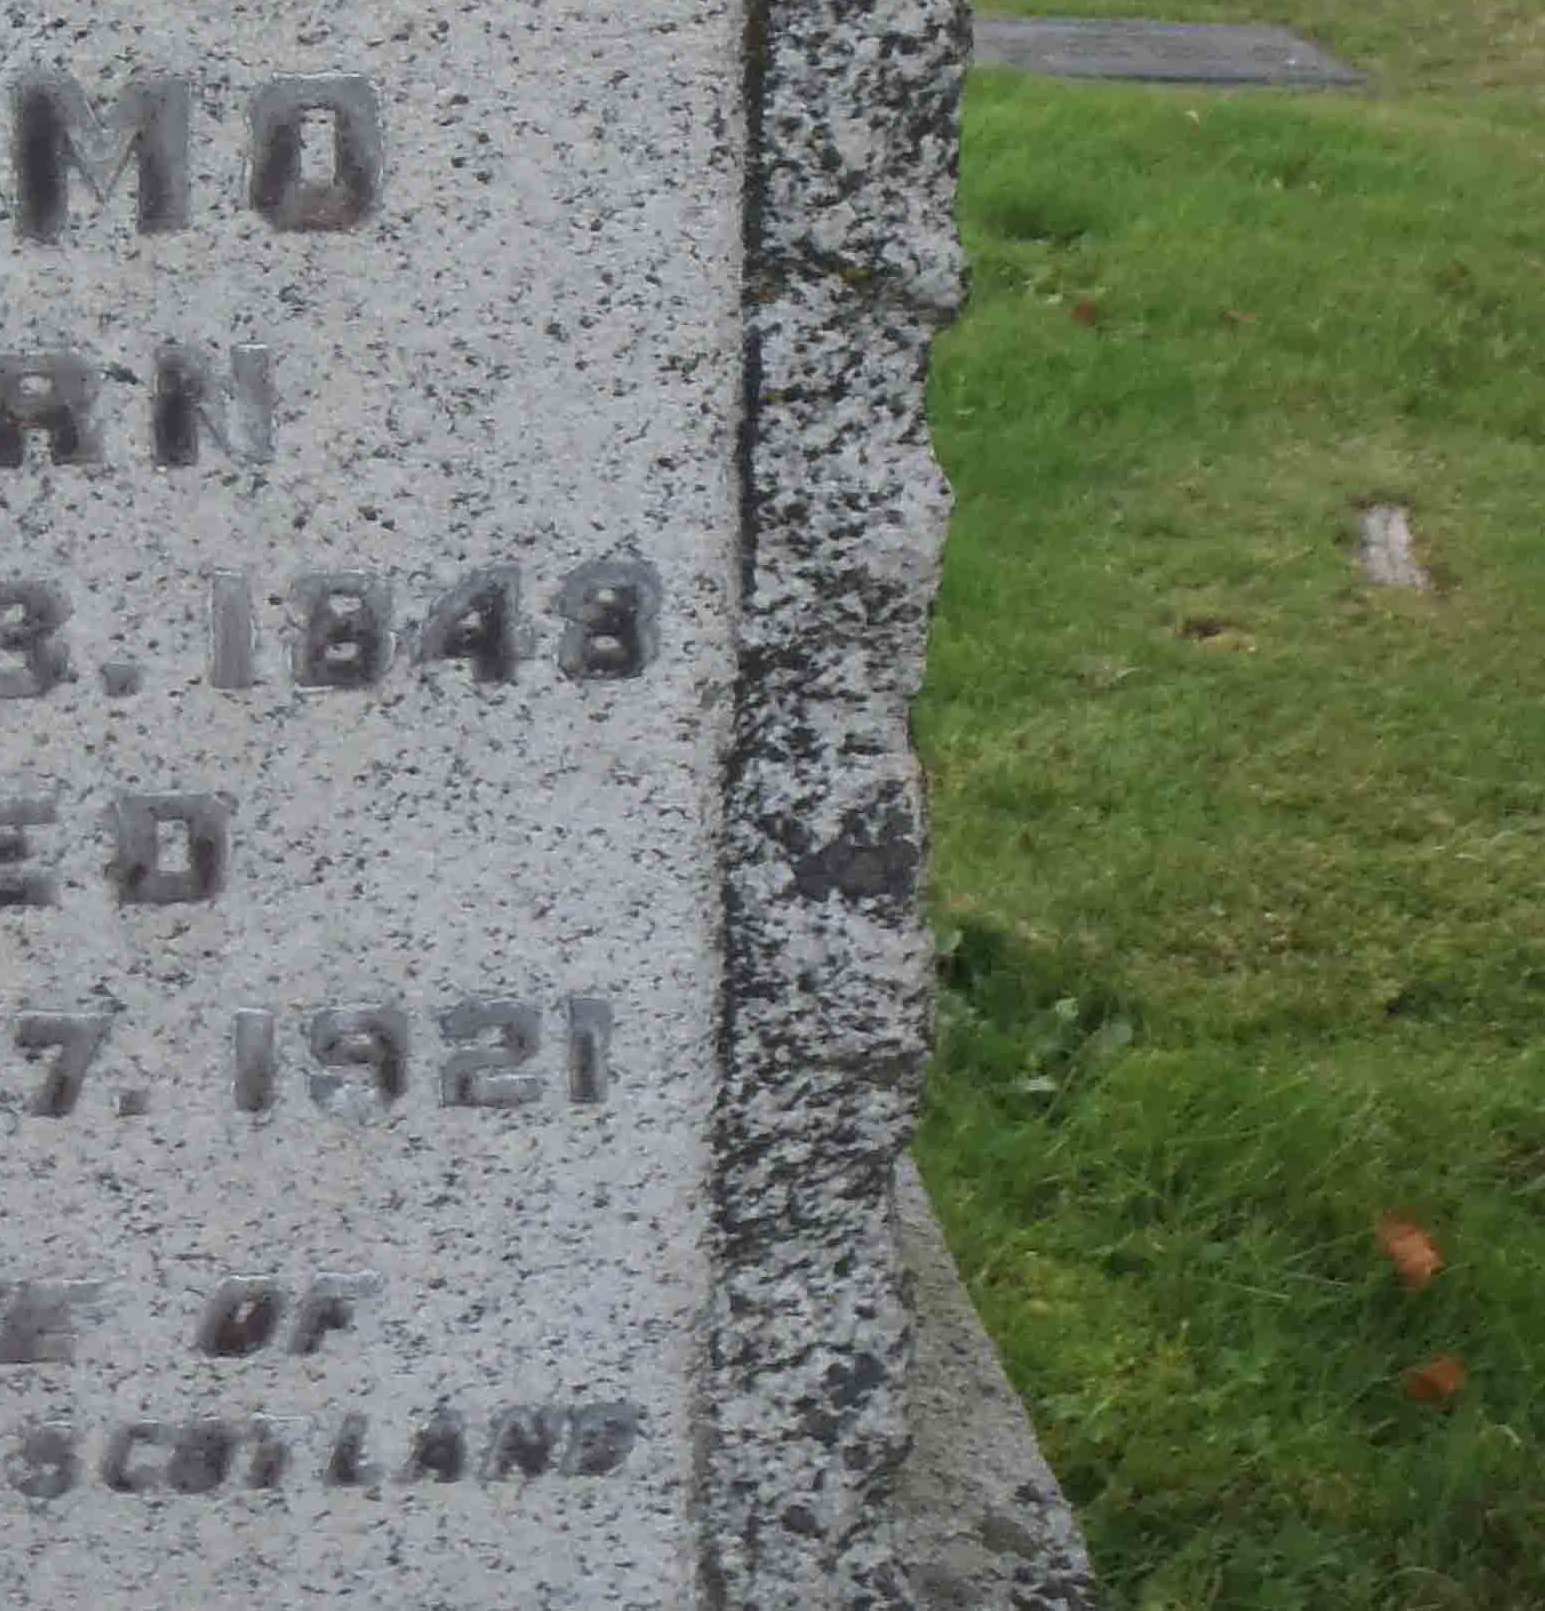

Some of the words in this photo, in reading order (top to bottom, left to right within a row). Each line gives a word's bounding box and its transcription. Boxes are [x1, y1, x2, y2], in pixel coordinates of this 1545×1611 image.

[210, 559, 660, 694] 1848
[233, 997, 613, 1124] 1921
[197, 1271, 385, 1357] OF
[7, 1402, 647, 1499] SCOTLAND
